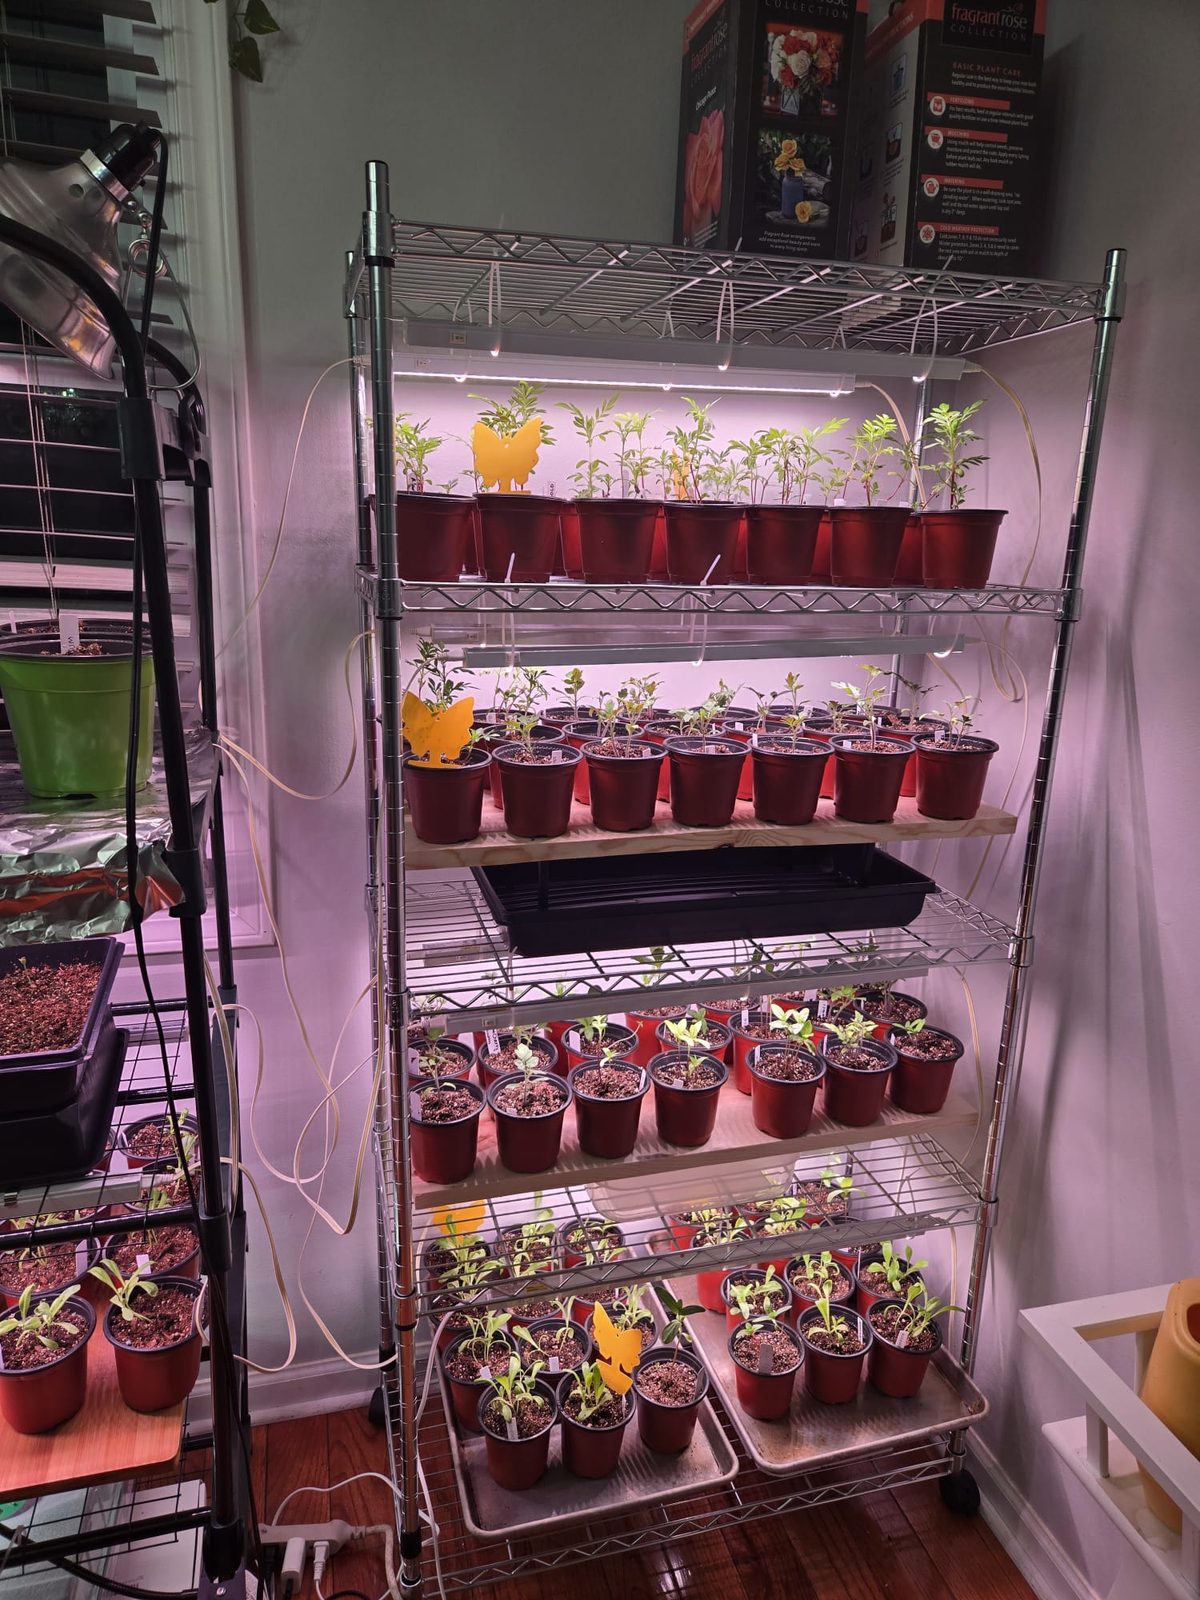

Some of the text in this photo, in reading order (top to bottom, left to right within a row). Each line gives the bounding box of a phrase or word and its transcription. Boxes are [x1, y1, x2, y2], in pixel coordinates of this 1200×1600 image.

[764, 0, 848, 20] COLLECTION
[950, 23, 1027, 42] COLLECTION
[952, 61, 975, 72] BASIC
[976, 65, 1000, 74] PLANT
